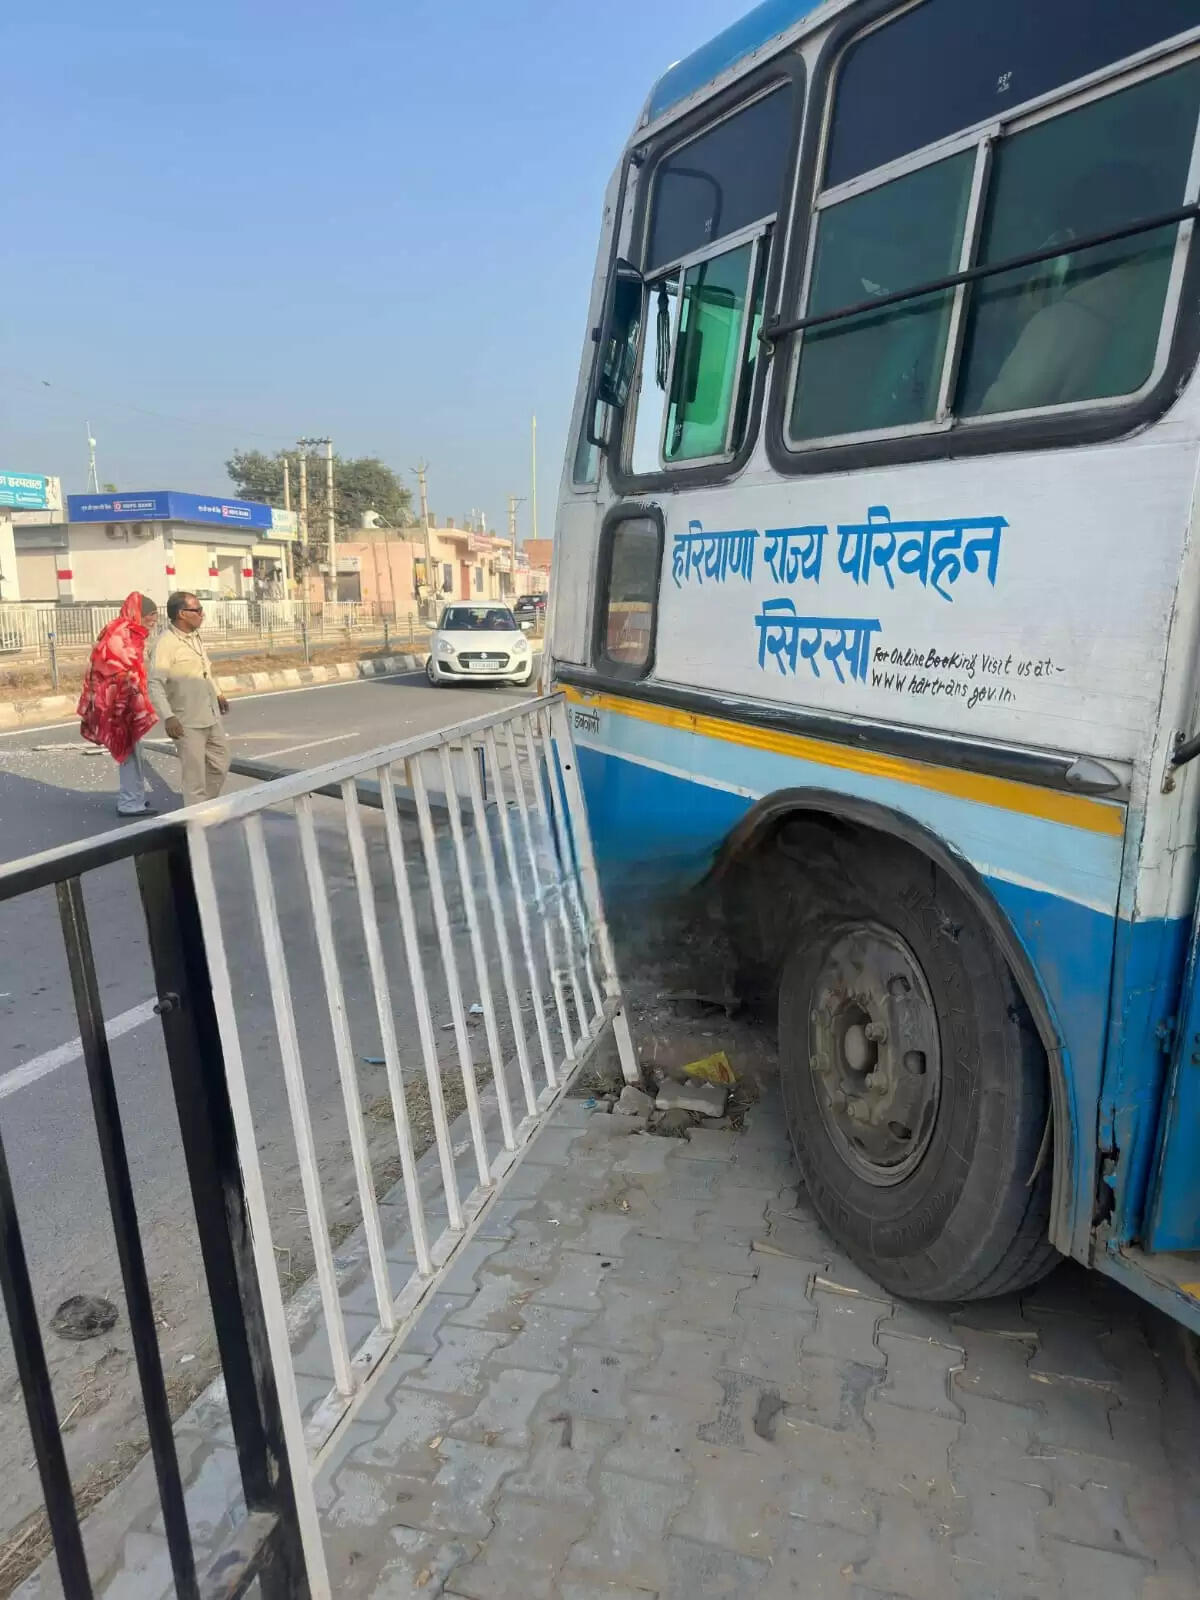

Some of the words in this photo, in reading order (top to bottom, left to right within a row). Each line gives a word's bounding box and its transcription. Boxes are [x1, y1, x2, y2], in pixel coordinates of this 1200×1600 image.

[673, 520, 760, 588] हरियाणा
[763, 525, 829, 585] राज्य
[837, 504, 1010, 602] परिवहन
[754, 598, 882, 684] सिरसा
[873, 646, 889, 663] For
[982, 653, 1013, 675] Visit
